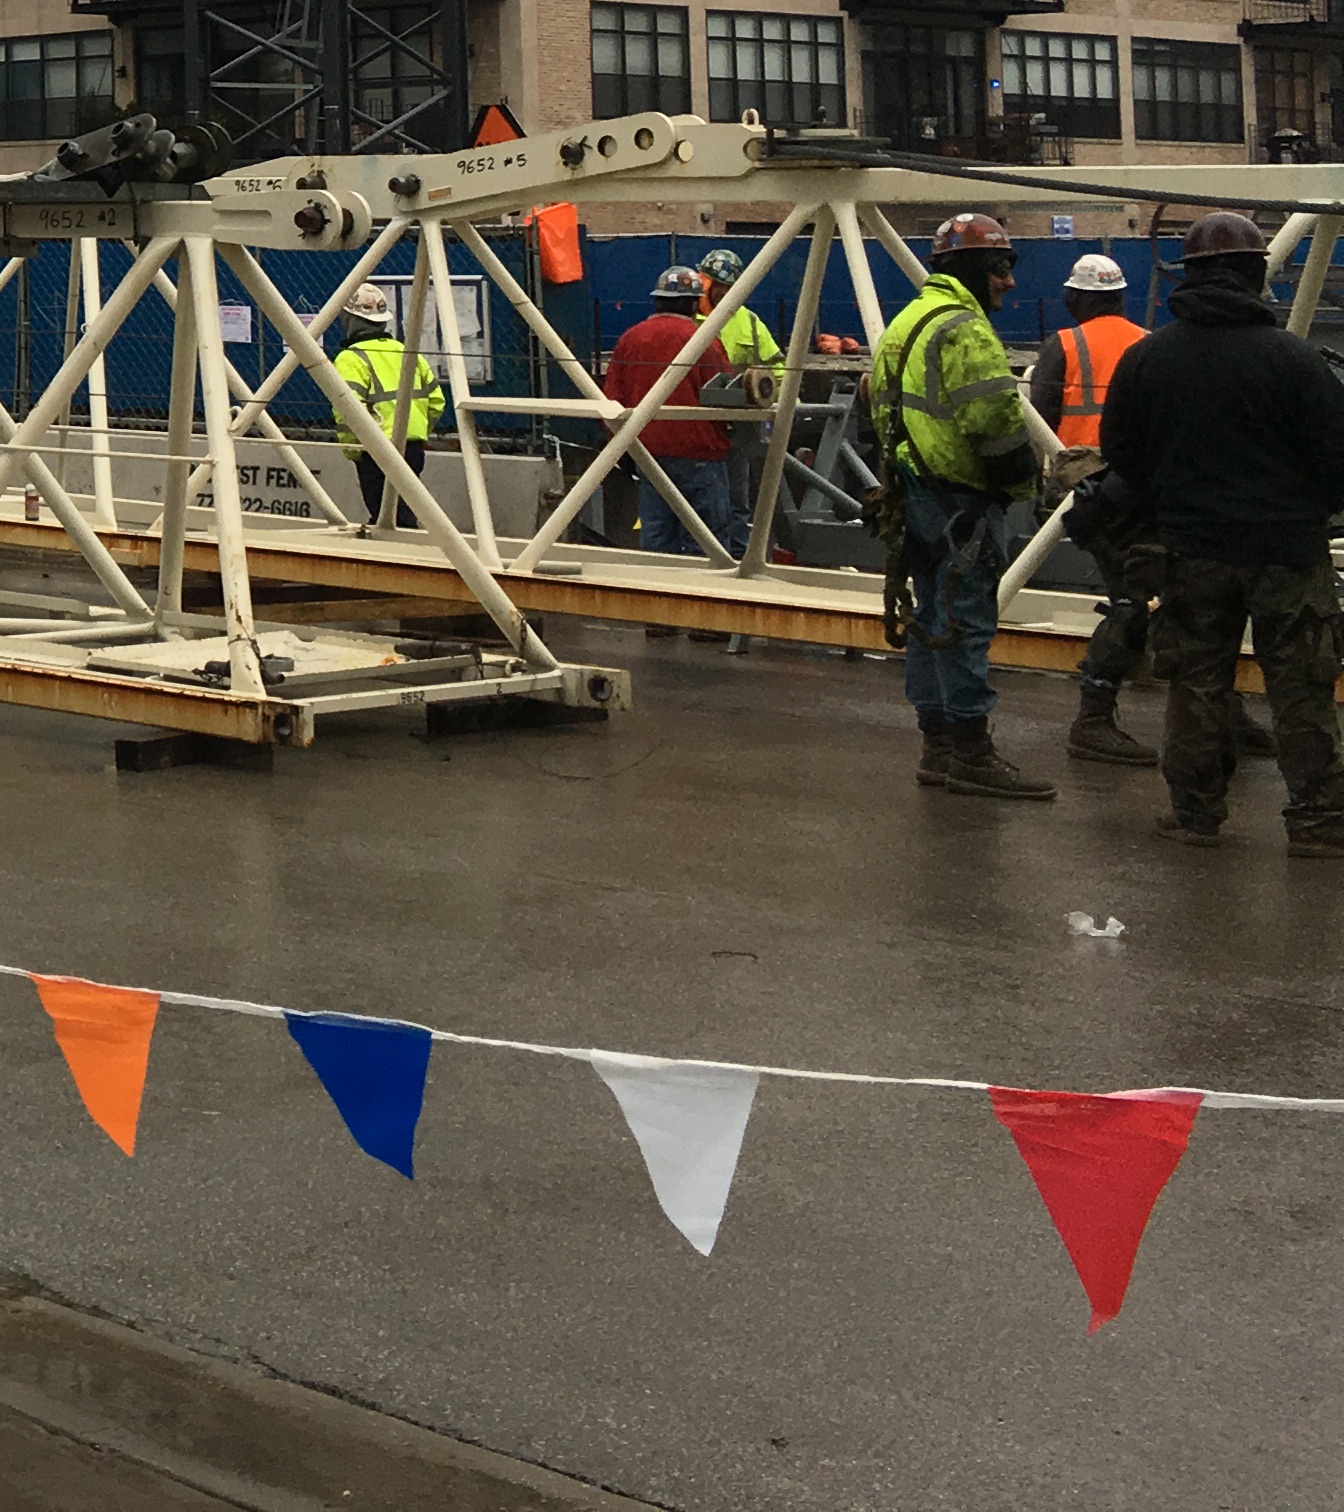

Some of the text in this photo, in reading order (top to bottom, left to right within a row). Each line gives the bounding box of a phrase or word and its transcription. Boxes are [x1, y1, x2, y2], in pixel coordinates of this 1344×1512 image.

[456, 156, 495, 175] 9652
[234, 178, 261, 192] 9652
[38, 209, 86, 230] 9652
